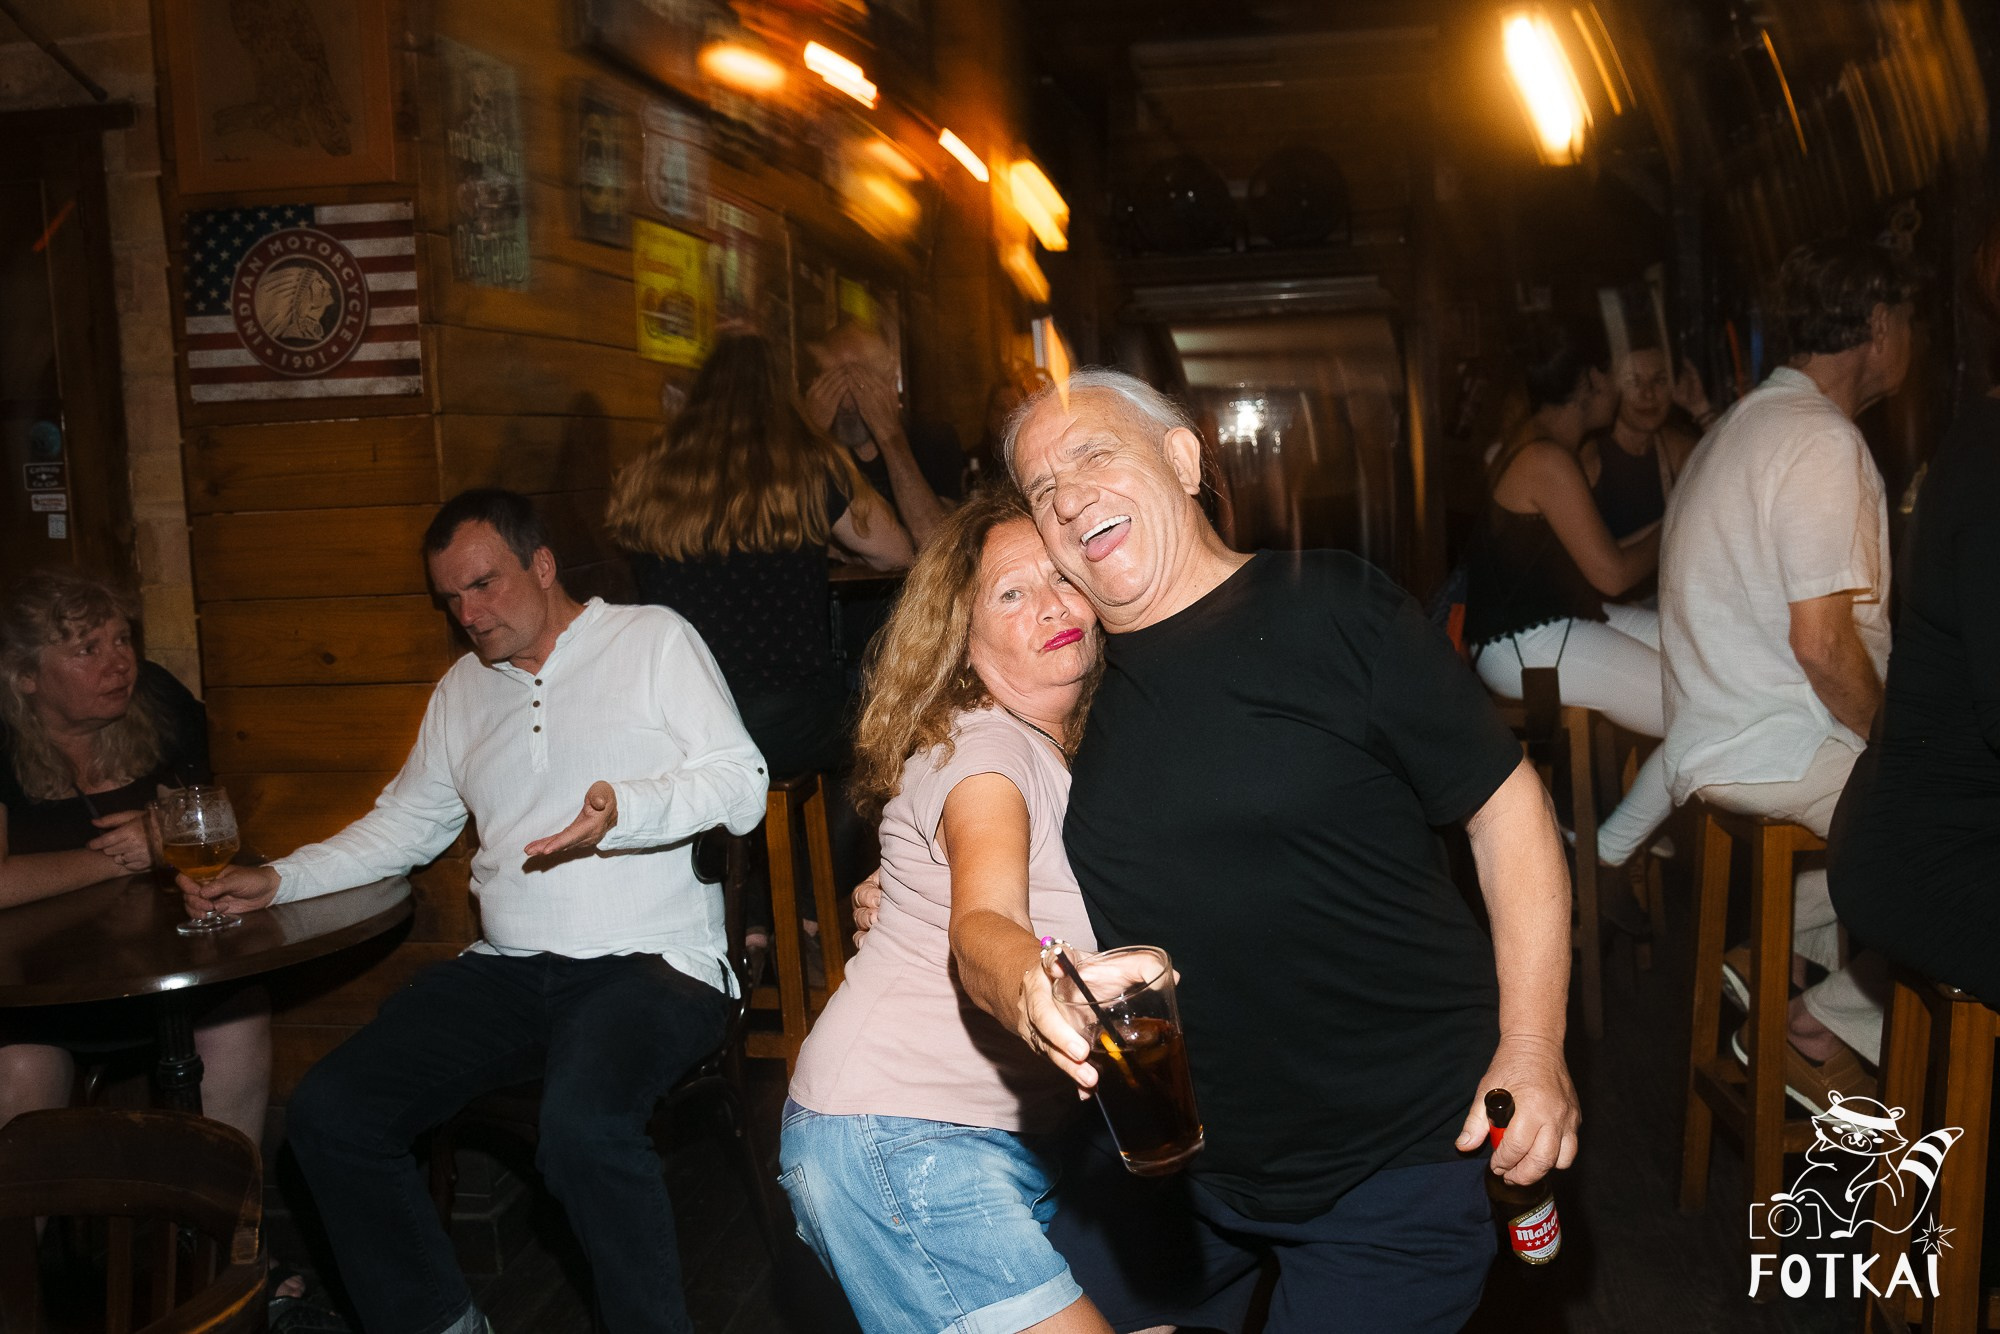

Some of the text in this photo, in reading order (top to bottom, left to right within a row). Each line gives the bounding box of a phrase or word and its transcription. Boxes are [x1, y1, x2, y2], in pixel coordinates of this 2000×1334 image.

[238, 235, 362, 347] INDIAN MOTORCYCLE
[280, 350, 328, 368] 1901
